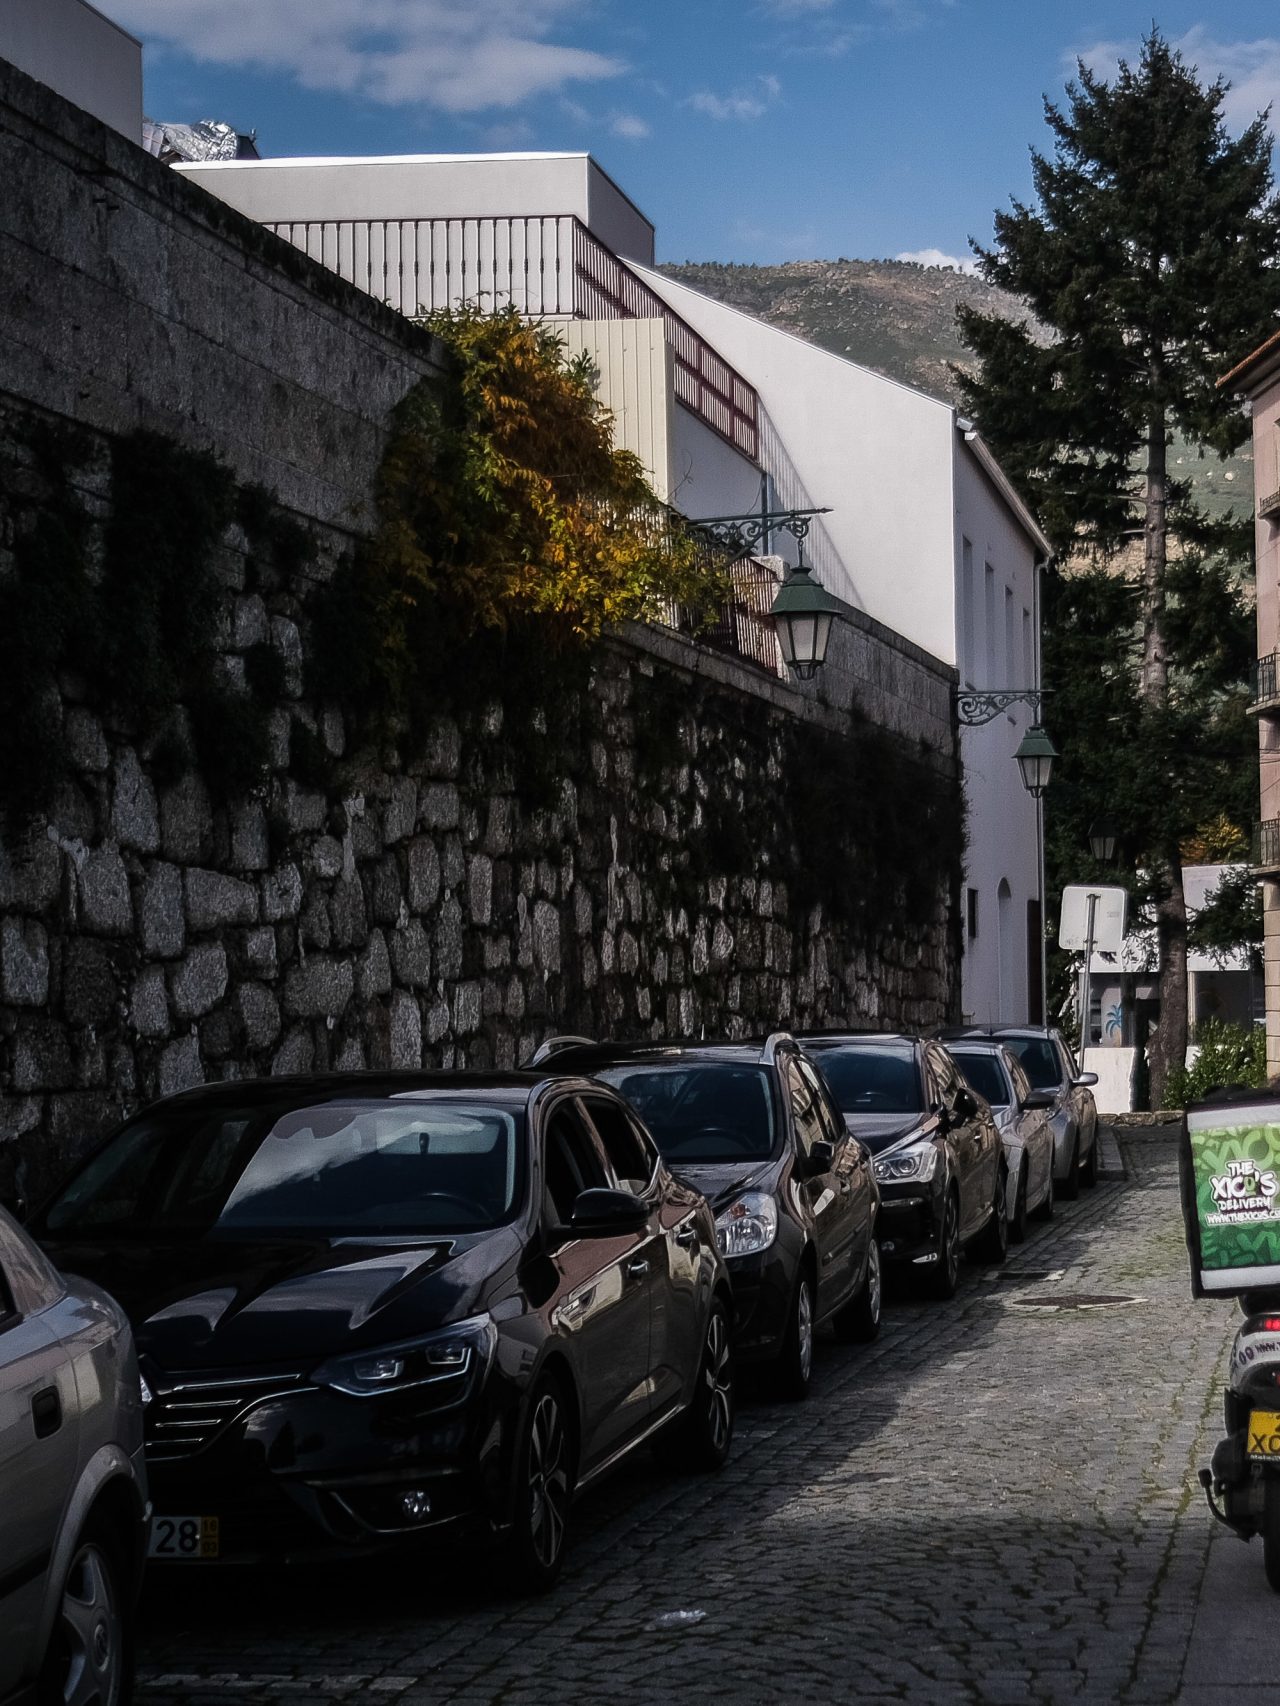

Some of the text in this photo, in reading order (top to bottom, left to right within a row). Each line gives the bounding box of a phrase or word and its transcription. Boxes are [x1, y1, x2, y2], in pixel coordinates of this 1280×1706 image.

[1227, 1161, 1255, 1177] THE
[1211, 1172, 1278, 1199] XICO'S
[1218, 1197, 1271, 1211] DELIVERY
[155, 1520, 199, 1553] 28
